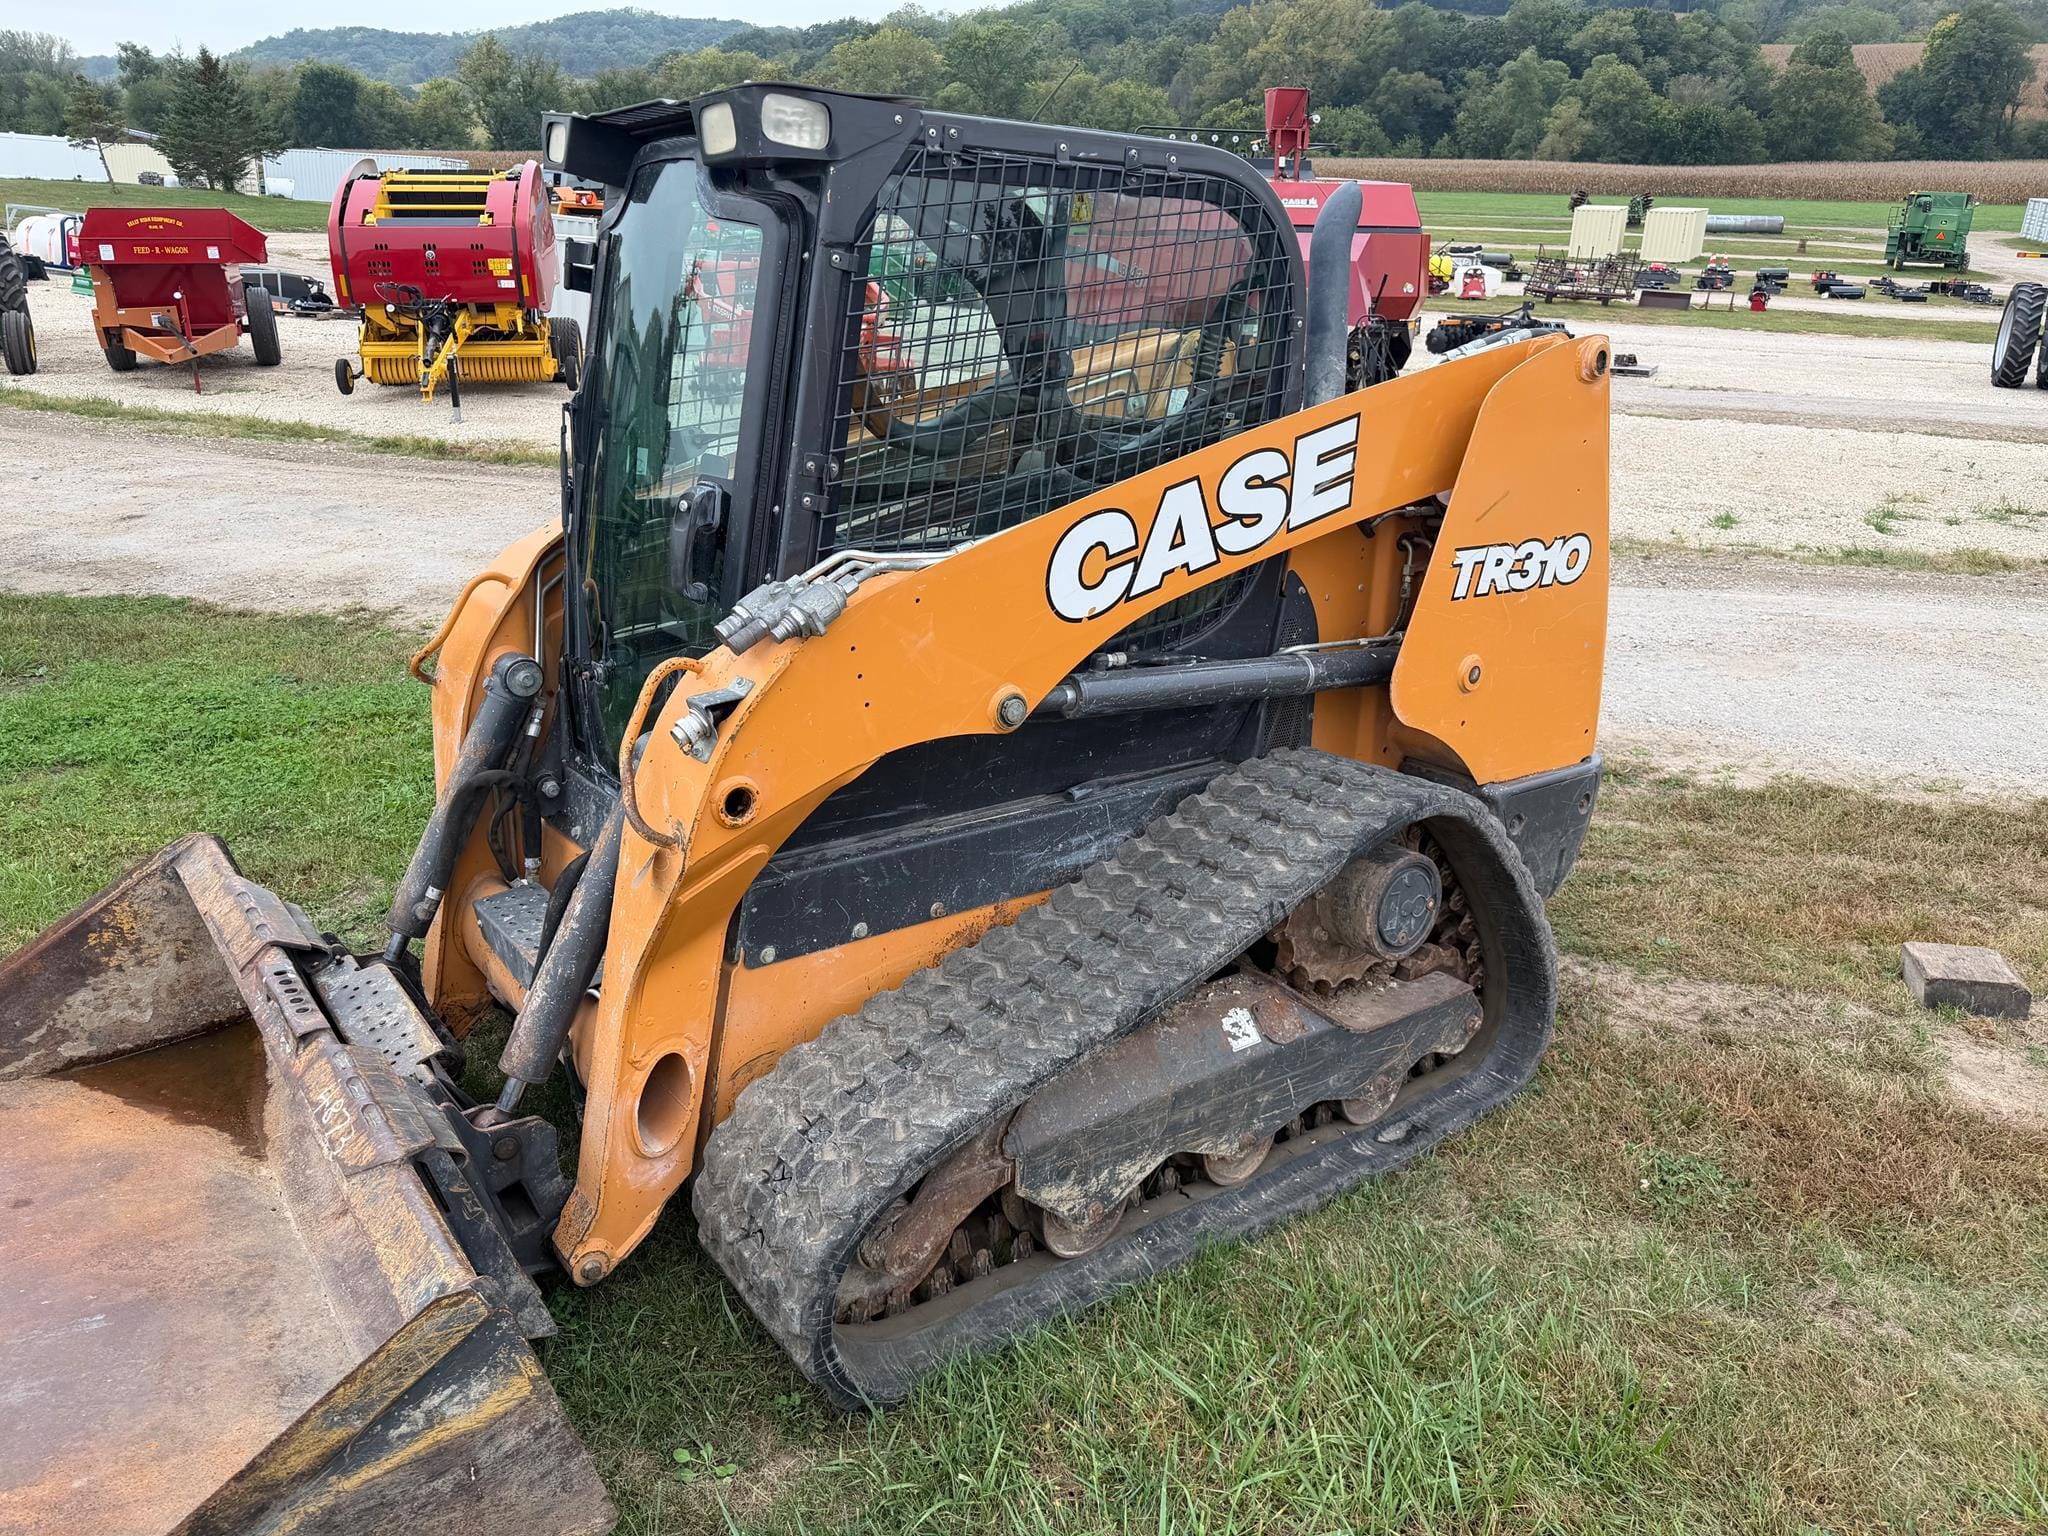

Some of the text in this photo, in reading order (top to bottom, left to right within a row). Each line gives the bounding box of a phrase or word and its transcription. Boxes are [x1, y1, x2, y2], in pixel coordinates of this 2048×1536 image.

[133, 246, 151, 254] FEED
[164, 246, 189, 254] WAGON
[1046, 412, 1361, 623] CASE
[1451, 532, 1592, 601] TR310
